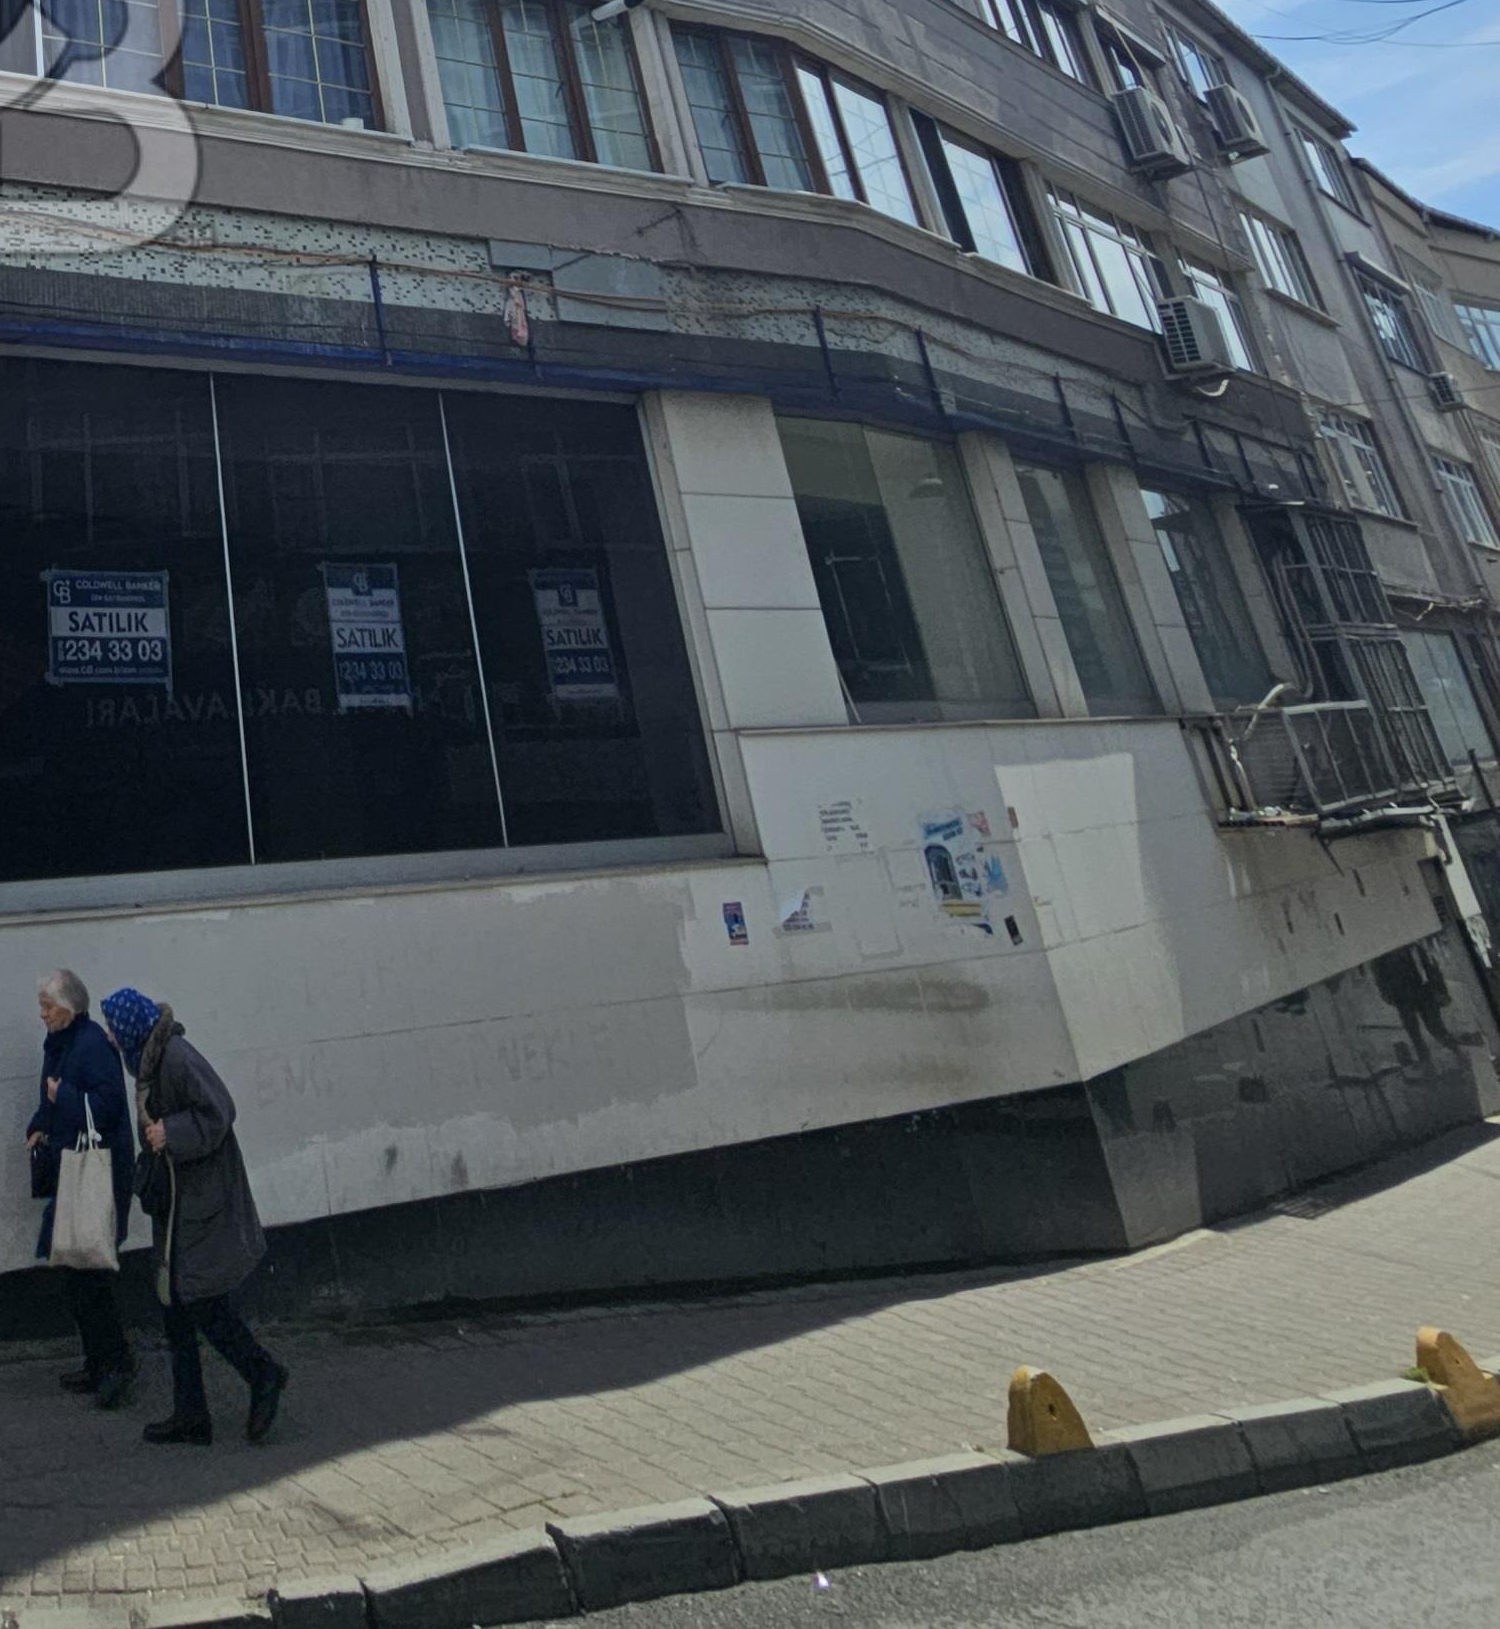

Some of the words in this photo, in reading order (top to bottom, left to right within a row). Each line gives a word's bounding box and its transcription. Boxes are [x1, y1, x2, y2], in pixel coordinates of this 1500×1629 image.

[75, 579, 122, 590] COLDWELL
[125, 580, 161, 590] BANKER
[68, 611, 148, 633] SATILIK
[336, 627, 399, 648] SATILIK
[546, 628, 603, 646] SATILIK
[65, 640, 102, 661] 234
[108, 640, 133, 661] 33
[138, 640, 162, 661] 03
